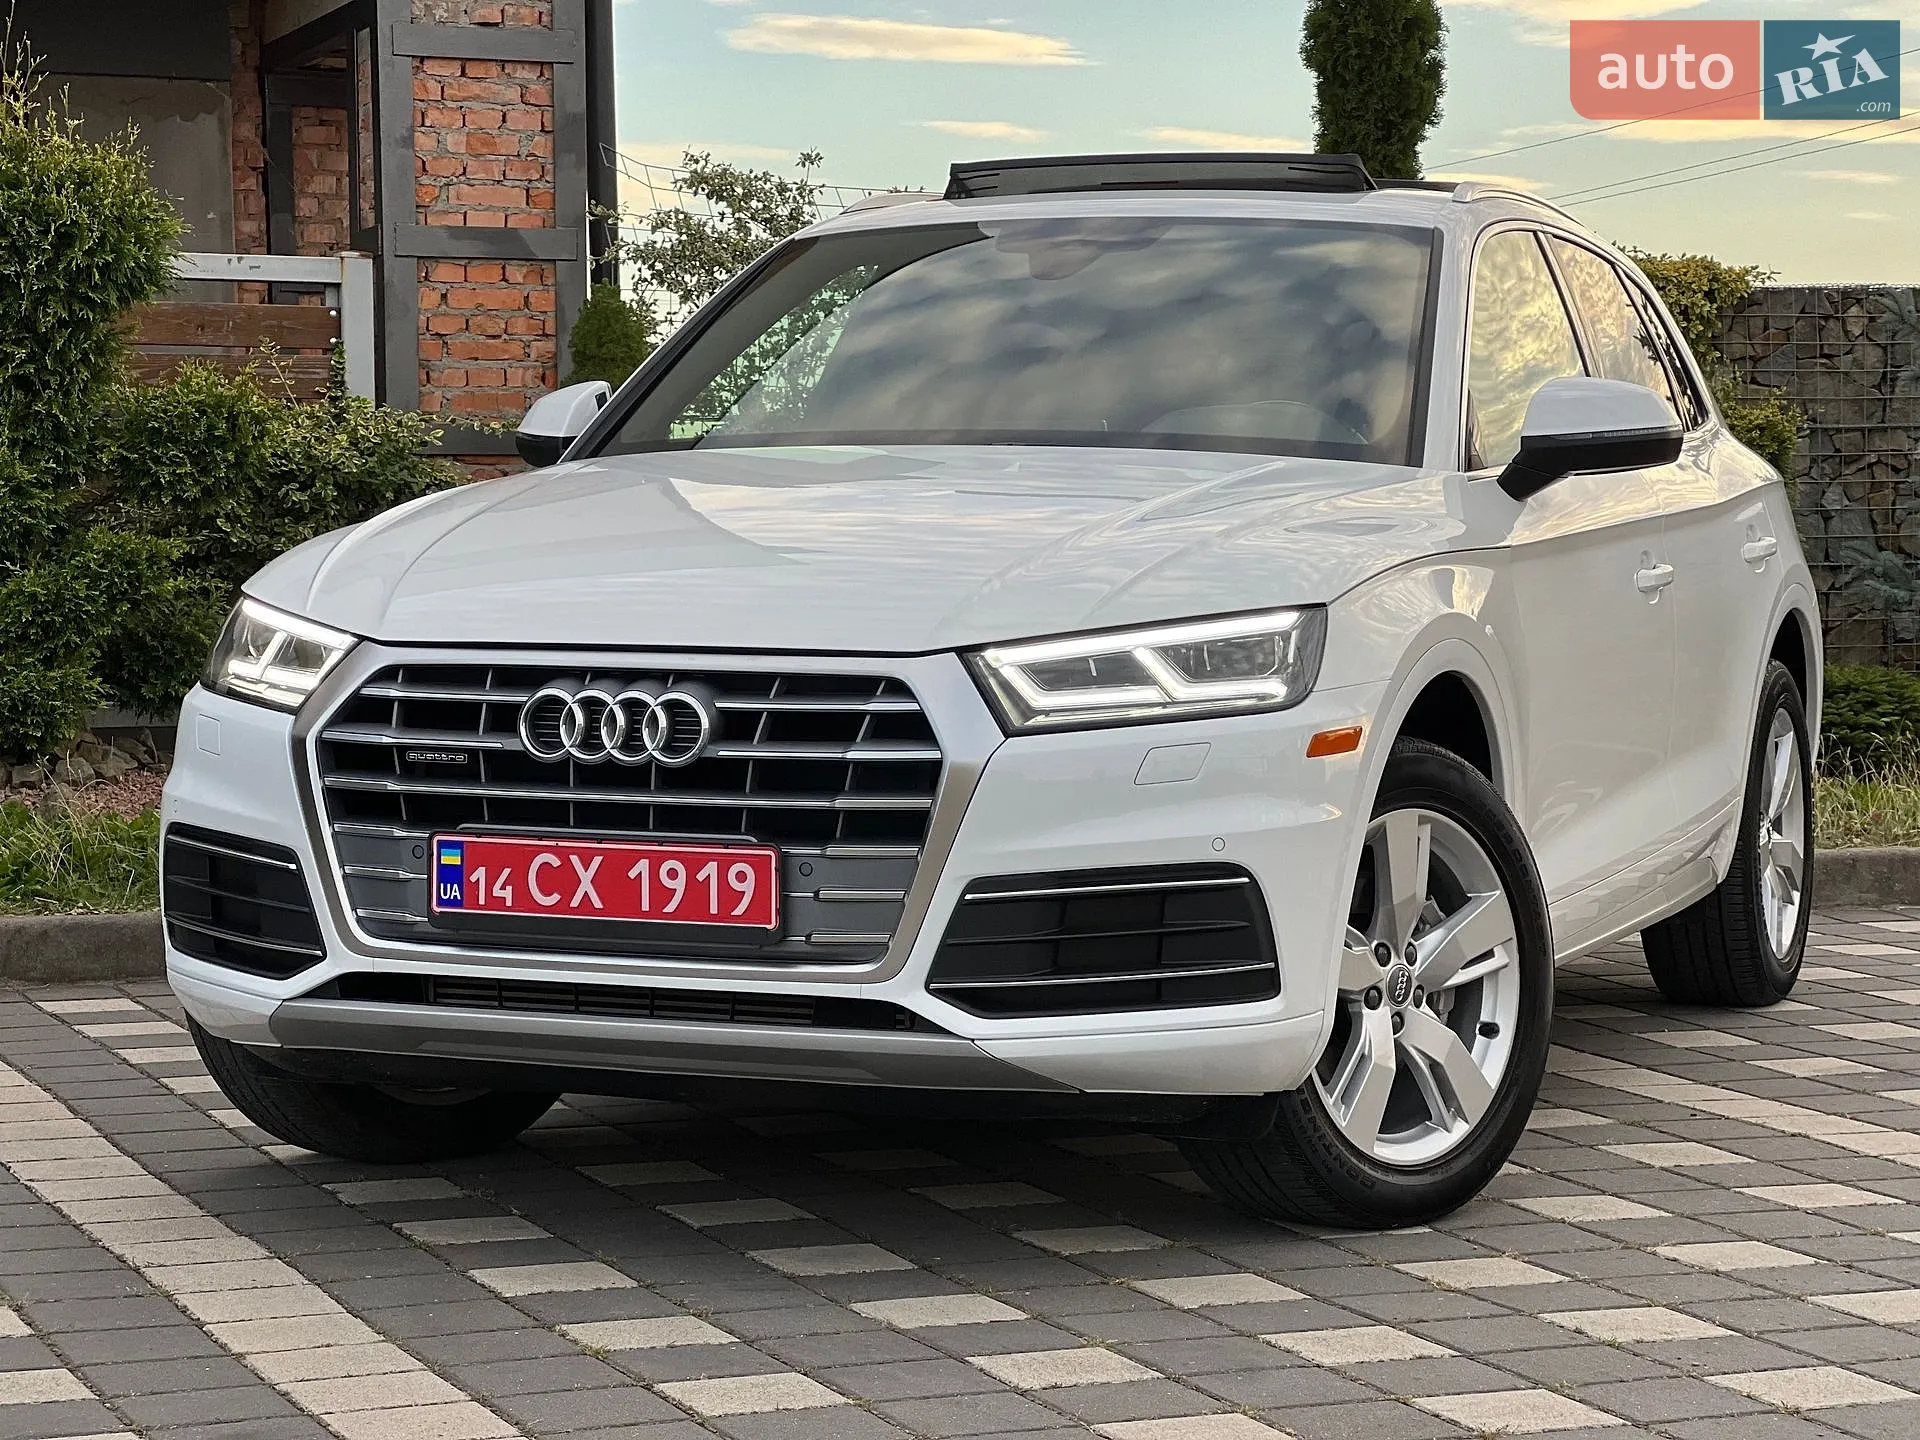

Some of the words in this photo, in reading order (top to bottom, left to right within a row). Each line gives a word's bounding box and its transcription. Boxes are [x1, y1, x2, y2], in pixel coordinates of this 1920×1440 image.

[408, 752, 465, 763] quattro
[440, 883, 461, 900] UA
[469, 866, 512, 907] 14
[627, 859, 756, 916] 1919
